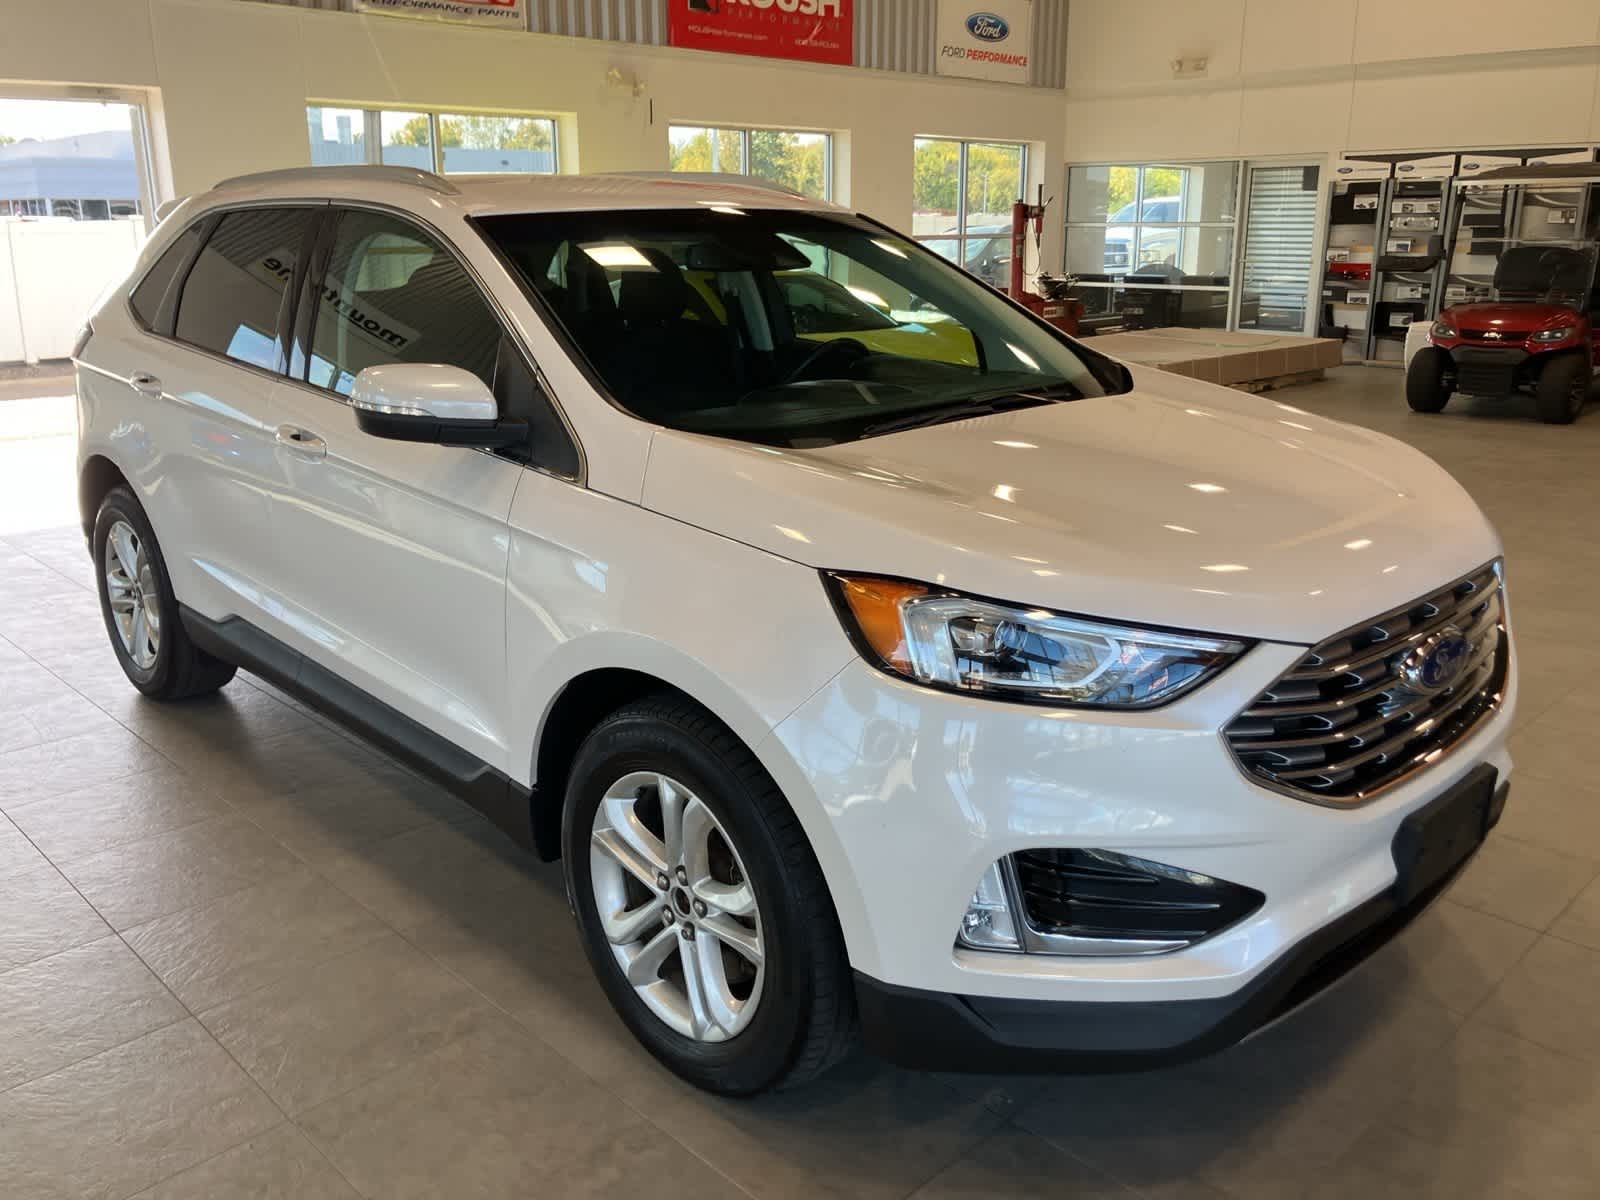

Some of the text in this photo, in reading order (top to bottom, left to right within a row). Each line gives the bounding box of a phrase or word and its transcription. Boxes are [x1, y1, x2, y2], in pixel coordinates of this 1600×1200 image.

[361, 0, 519, 18] ERFORMANCE PARTS
[972, 15, 1003, 39] Ford
[941, 45, 1027, 66] FORD PERFORMANCE
